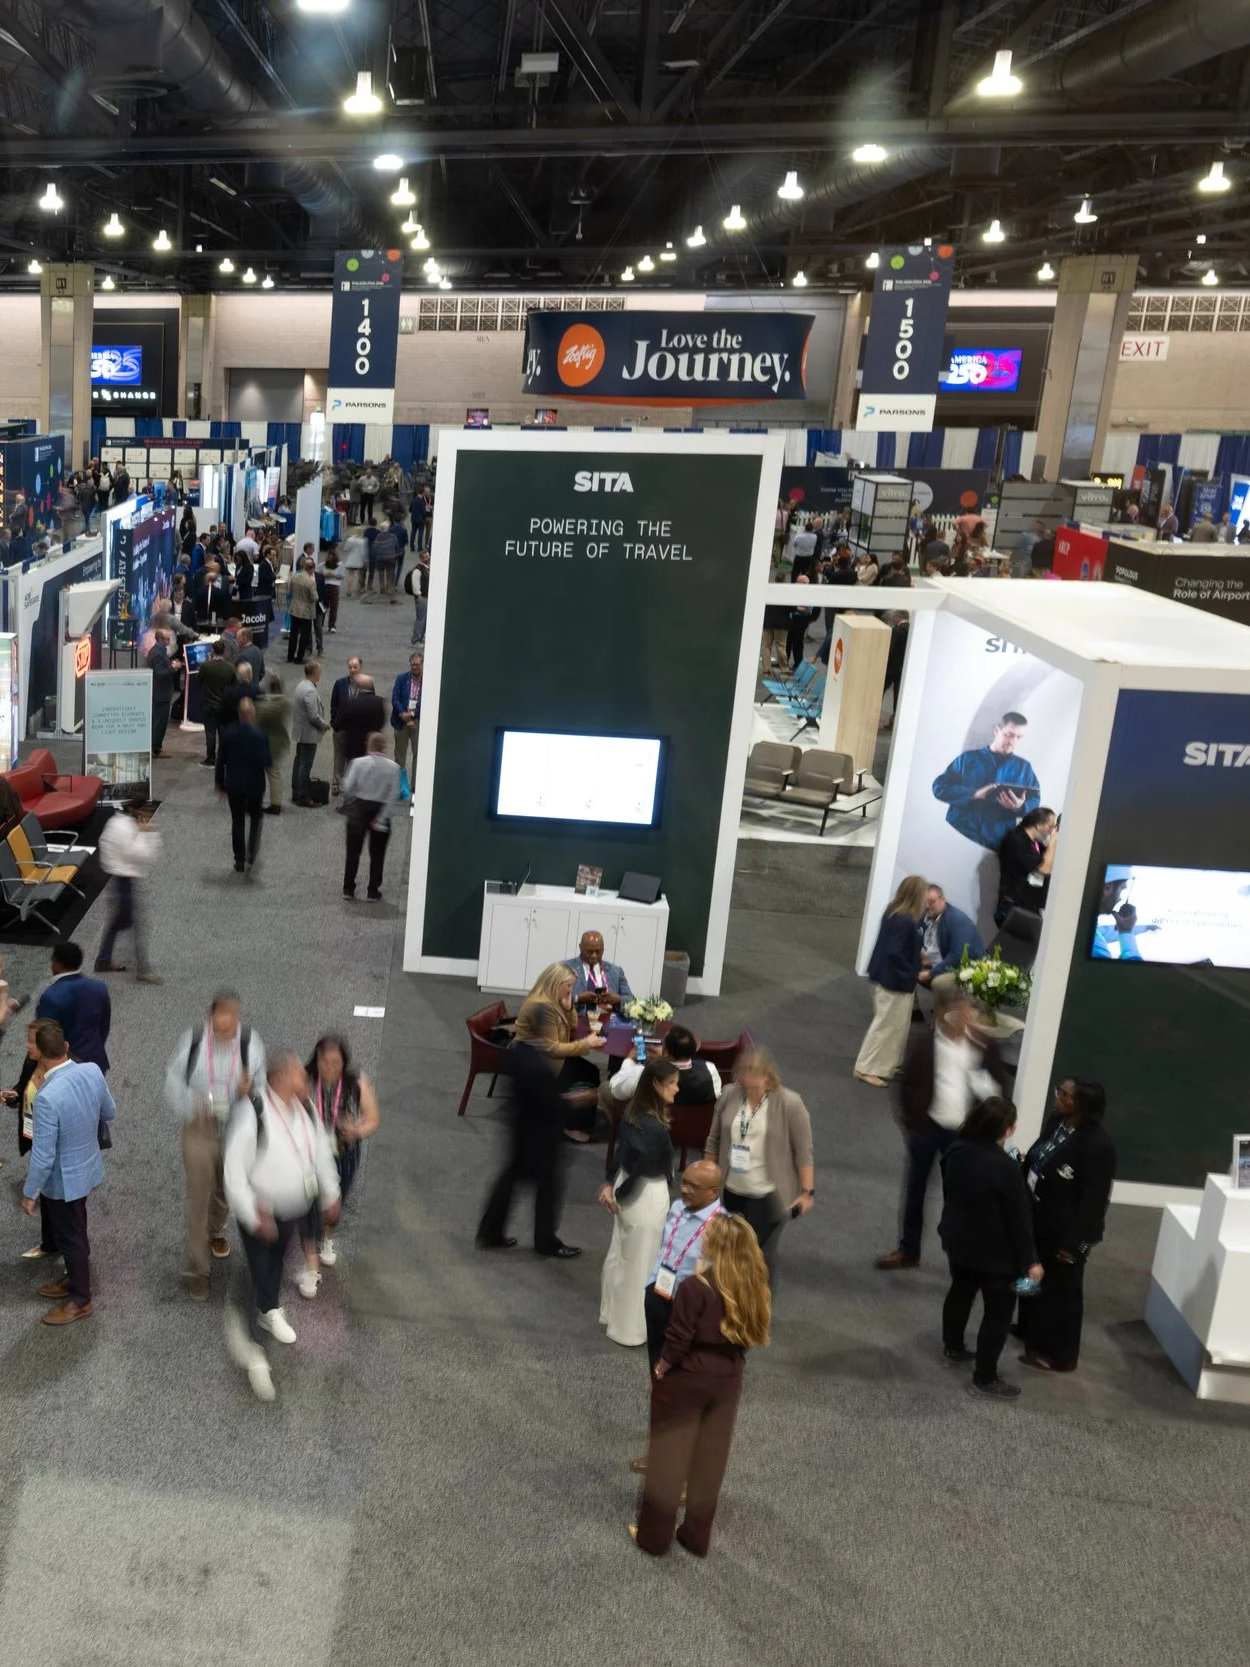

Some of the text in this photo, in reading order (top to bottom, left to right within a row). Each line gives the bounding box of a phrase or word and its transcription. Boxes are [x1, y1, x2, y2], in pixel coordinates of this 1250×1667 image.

[354, 298, 372, 375] 1400
[660, 328, 743, 349] Love the
[892, 297, 914, 380] 1500
[1121, 341, 1165, 357] EXIT
[622, 339, 791, 394] Journey.
[573, 471, 634, 493] SITA
[530, 517, 672, 537] POWERING THE
[505, 540, 693, 561] FUTURE OF TRAVEL
[1174, 577, 1244, 589] Changing the
[1173, 589, 1250, 601] Role of Airport
[985, 636, 1027, 654] SI
